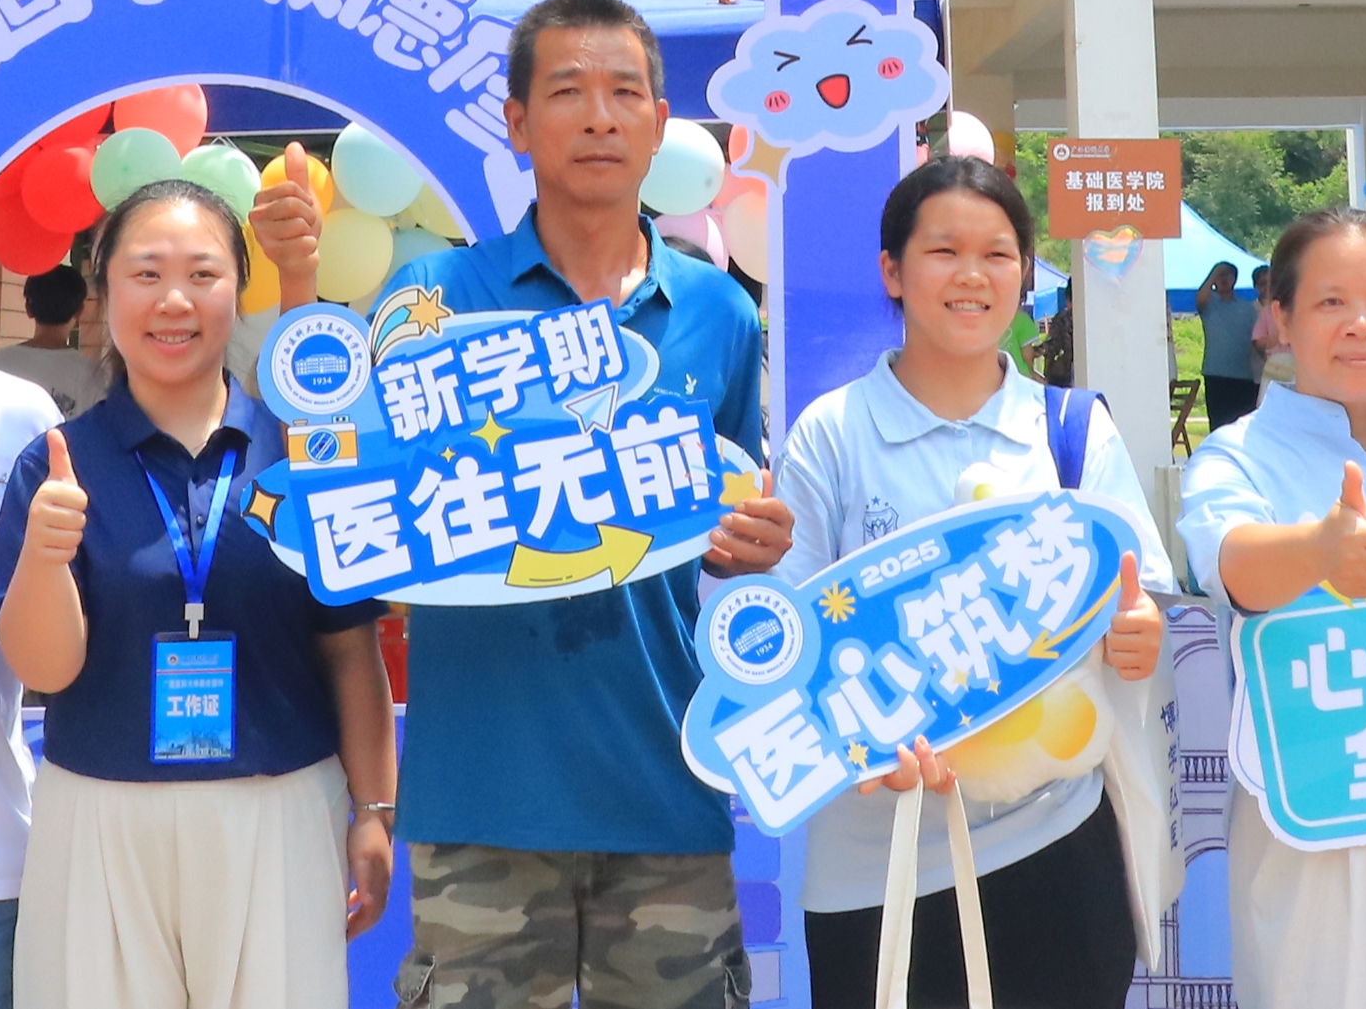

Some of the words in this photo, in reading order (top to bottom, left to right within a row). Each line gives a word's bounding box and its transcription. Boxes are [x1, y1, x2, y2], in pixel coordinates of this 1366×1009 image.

[1065, 170, 1165, 191] 基础医学院
[1085, 192, 1146, 212] 报到处
[312, 376, 333, 386] 1934
[376, 303, 624, 442] 新学期
[307, 406, 710, 593] 医往无前
[860, 539, 940, 589] 2025
[755, 641, 774, 657] 1934
[714, 502, 1090, 828] 医心筑梦
[166, 694, 220, 717] 工作证
